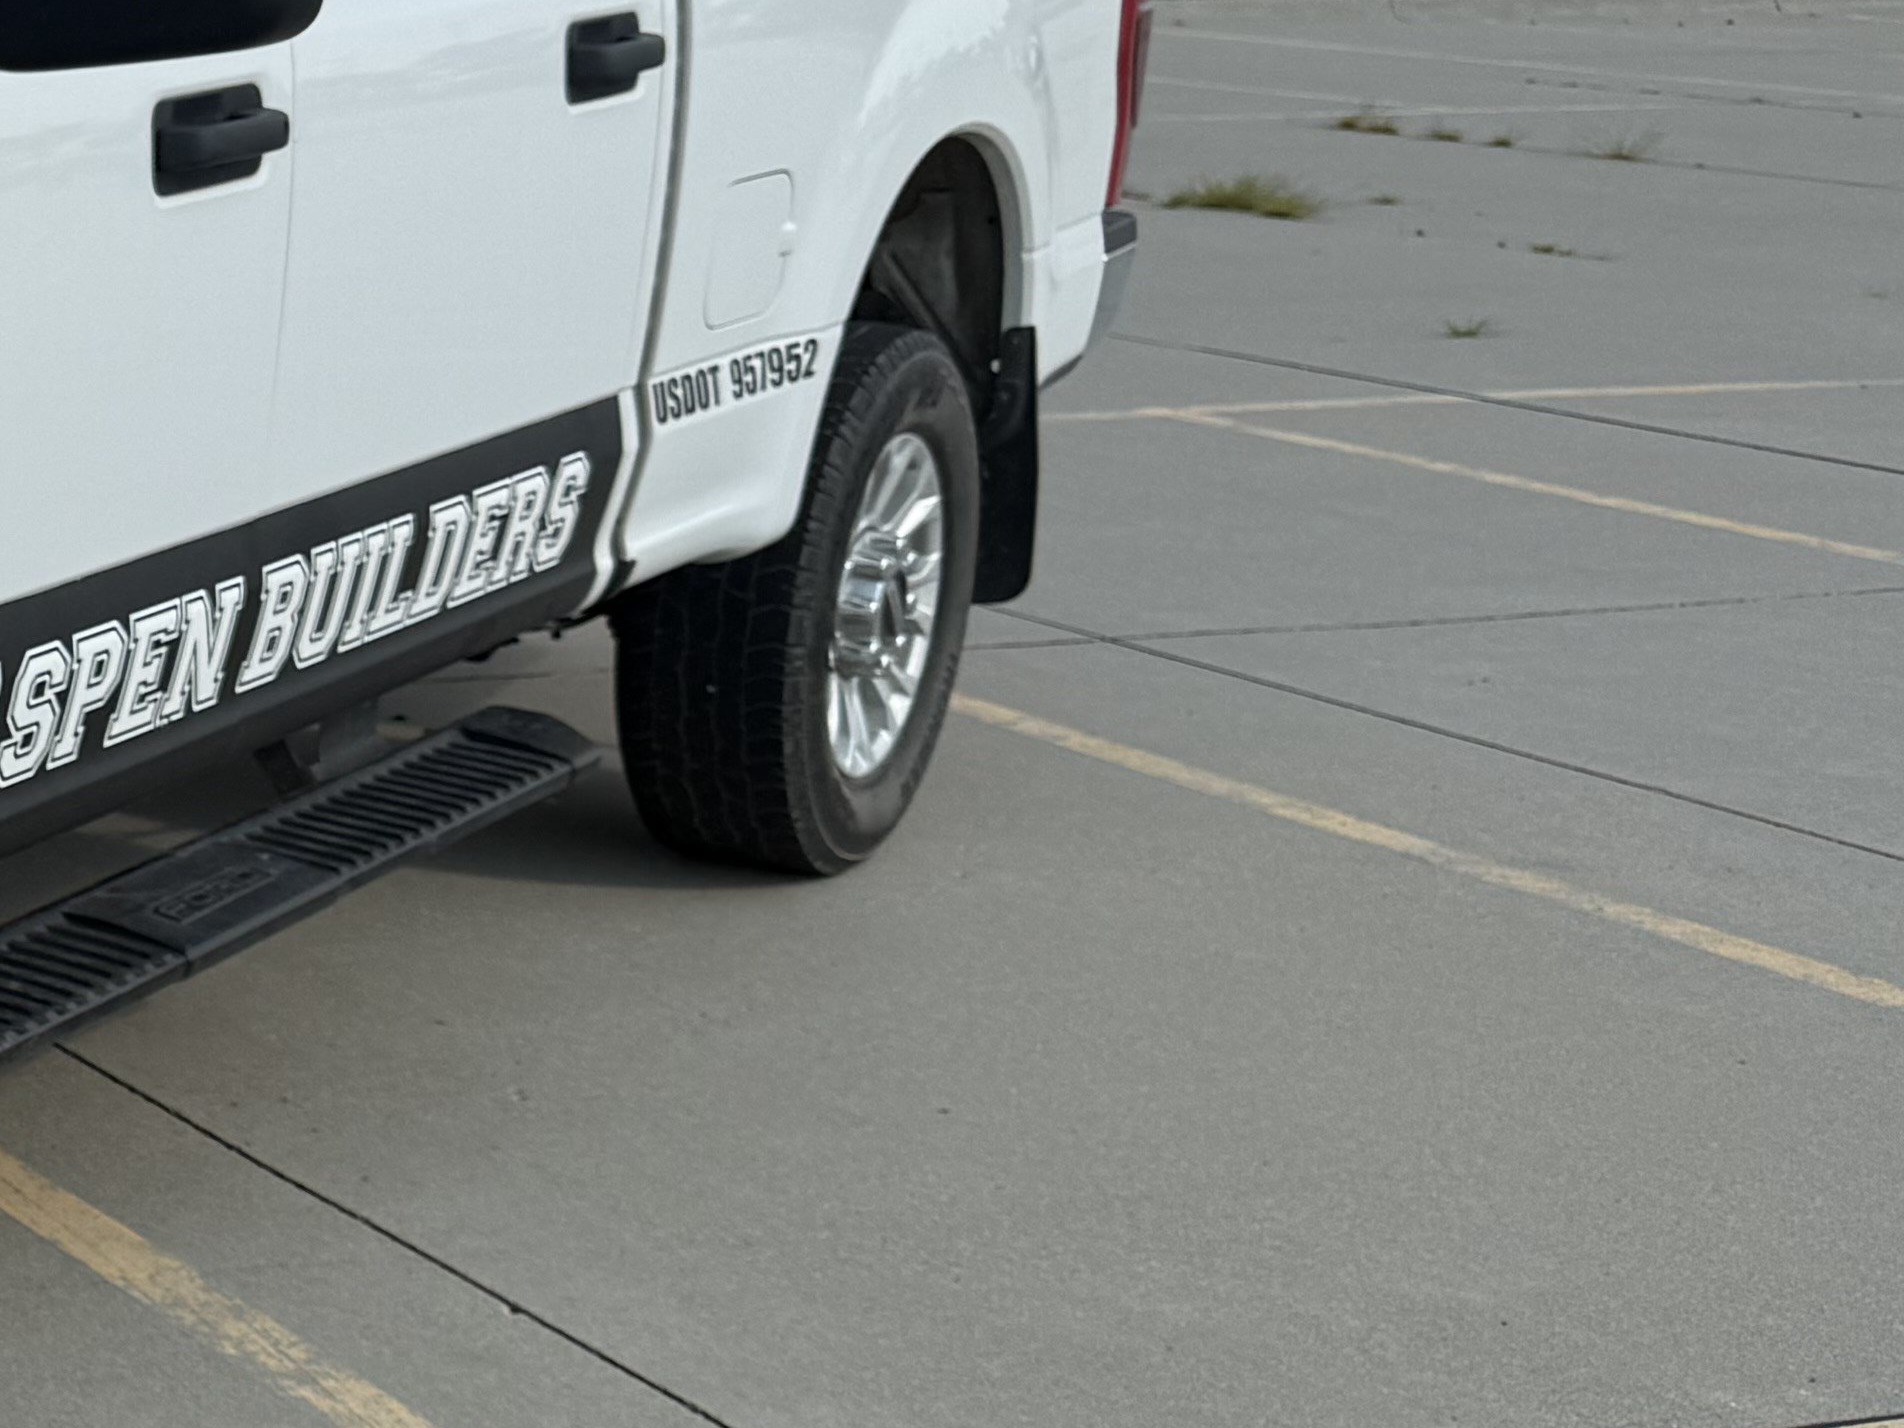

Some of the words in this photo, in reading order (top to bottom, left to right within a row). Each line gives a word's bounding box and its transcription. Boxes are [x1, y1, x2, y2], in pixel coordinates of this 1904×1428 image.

[652, 365, 721, 424] USDOT
[730, 338, 819, 402] 957952
[234, 450, 591, 694] BUILDERS
